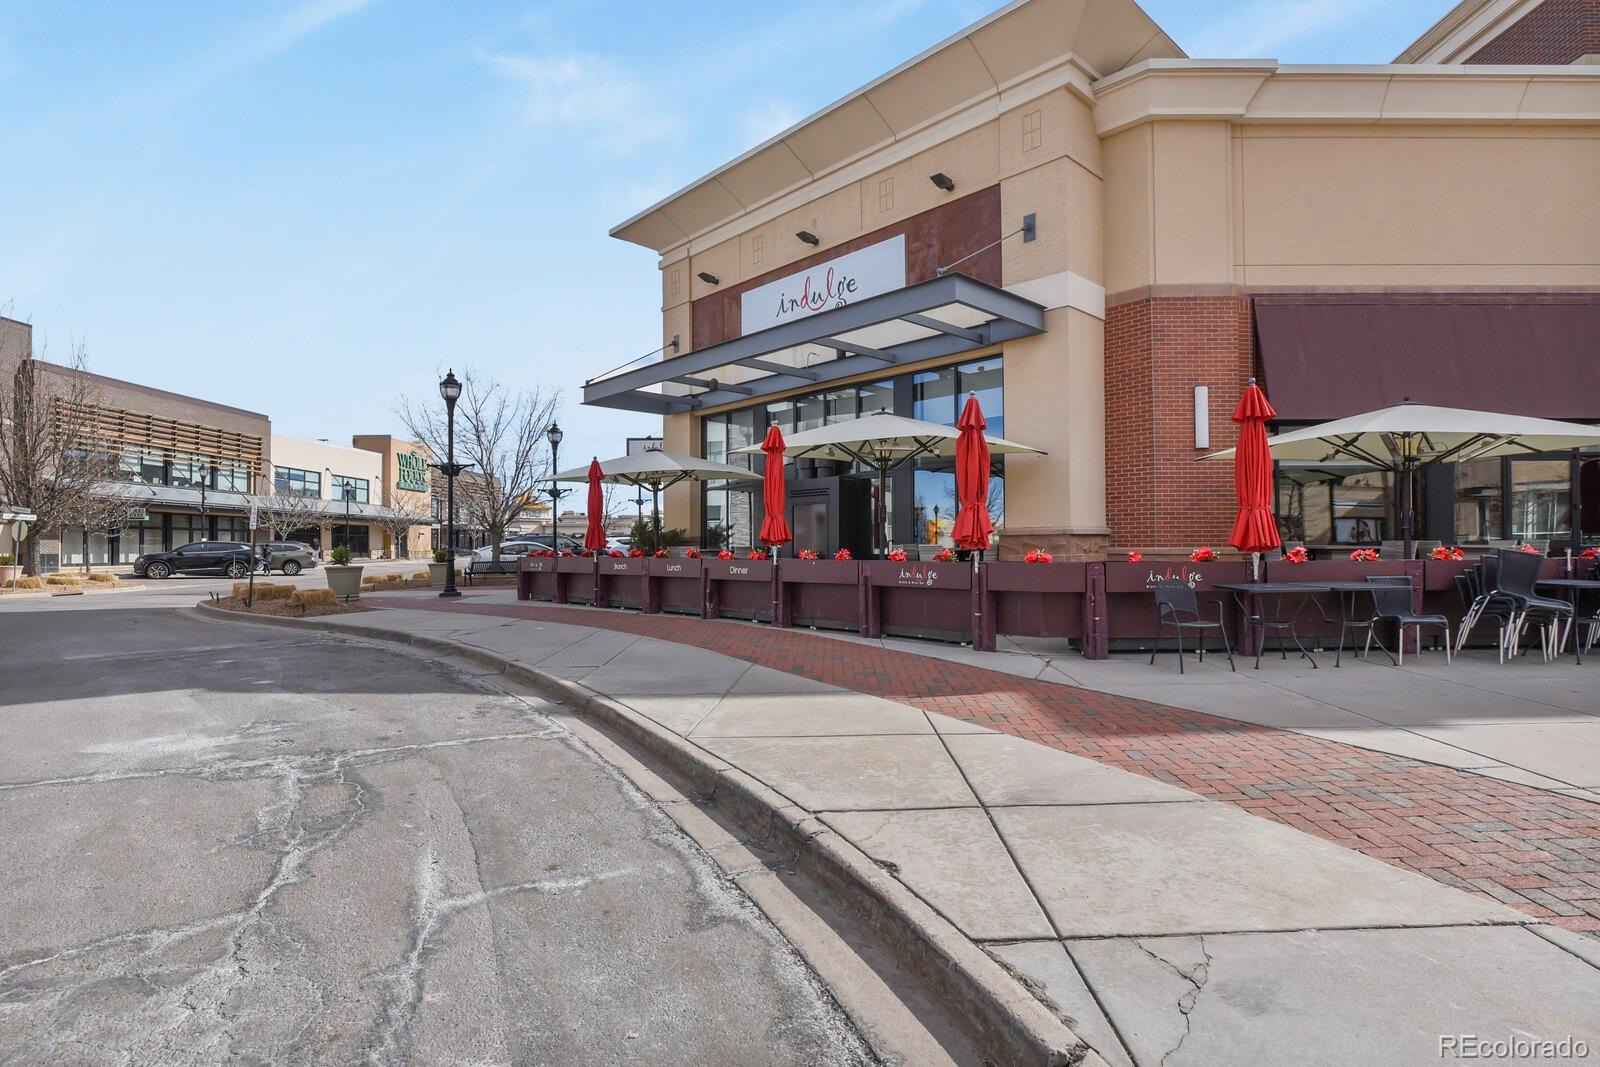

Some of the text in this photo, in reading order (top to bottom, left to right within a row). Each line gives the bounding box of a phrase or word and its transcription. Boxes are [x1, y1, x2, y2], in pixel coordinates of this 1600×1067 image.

[776, 267, 859, 317] indulge
[666, 564, 682, 572] Lunch
[729, 566, 749, 575] Dinner
